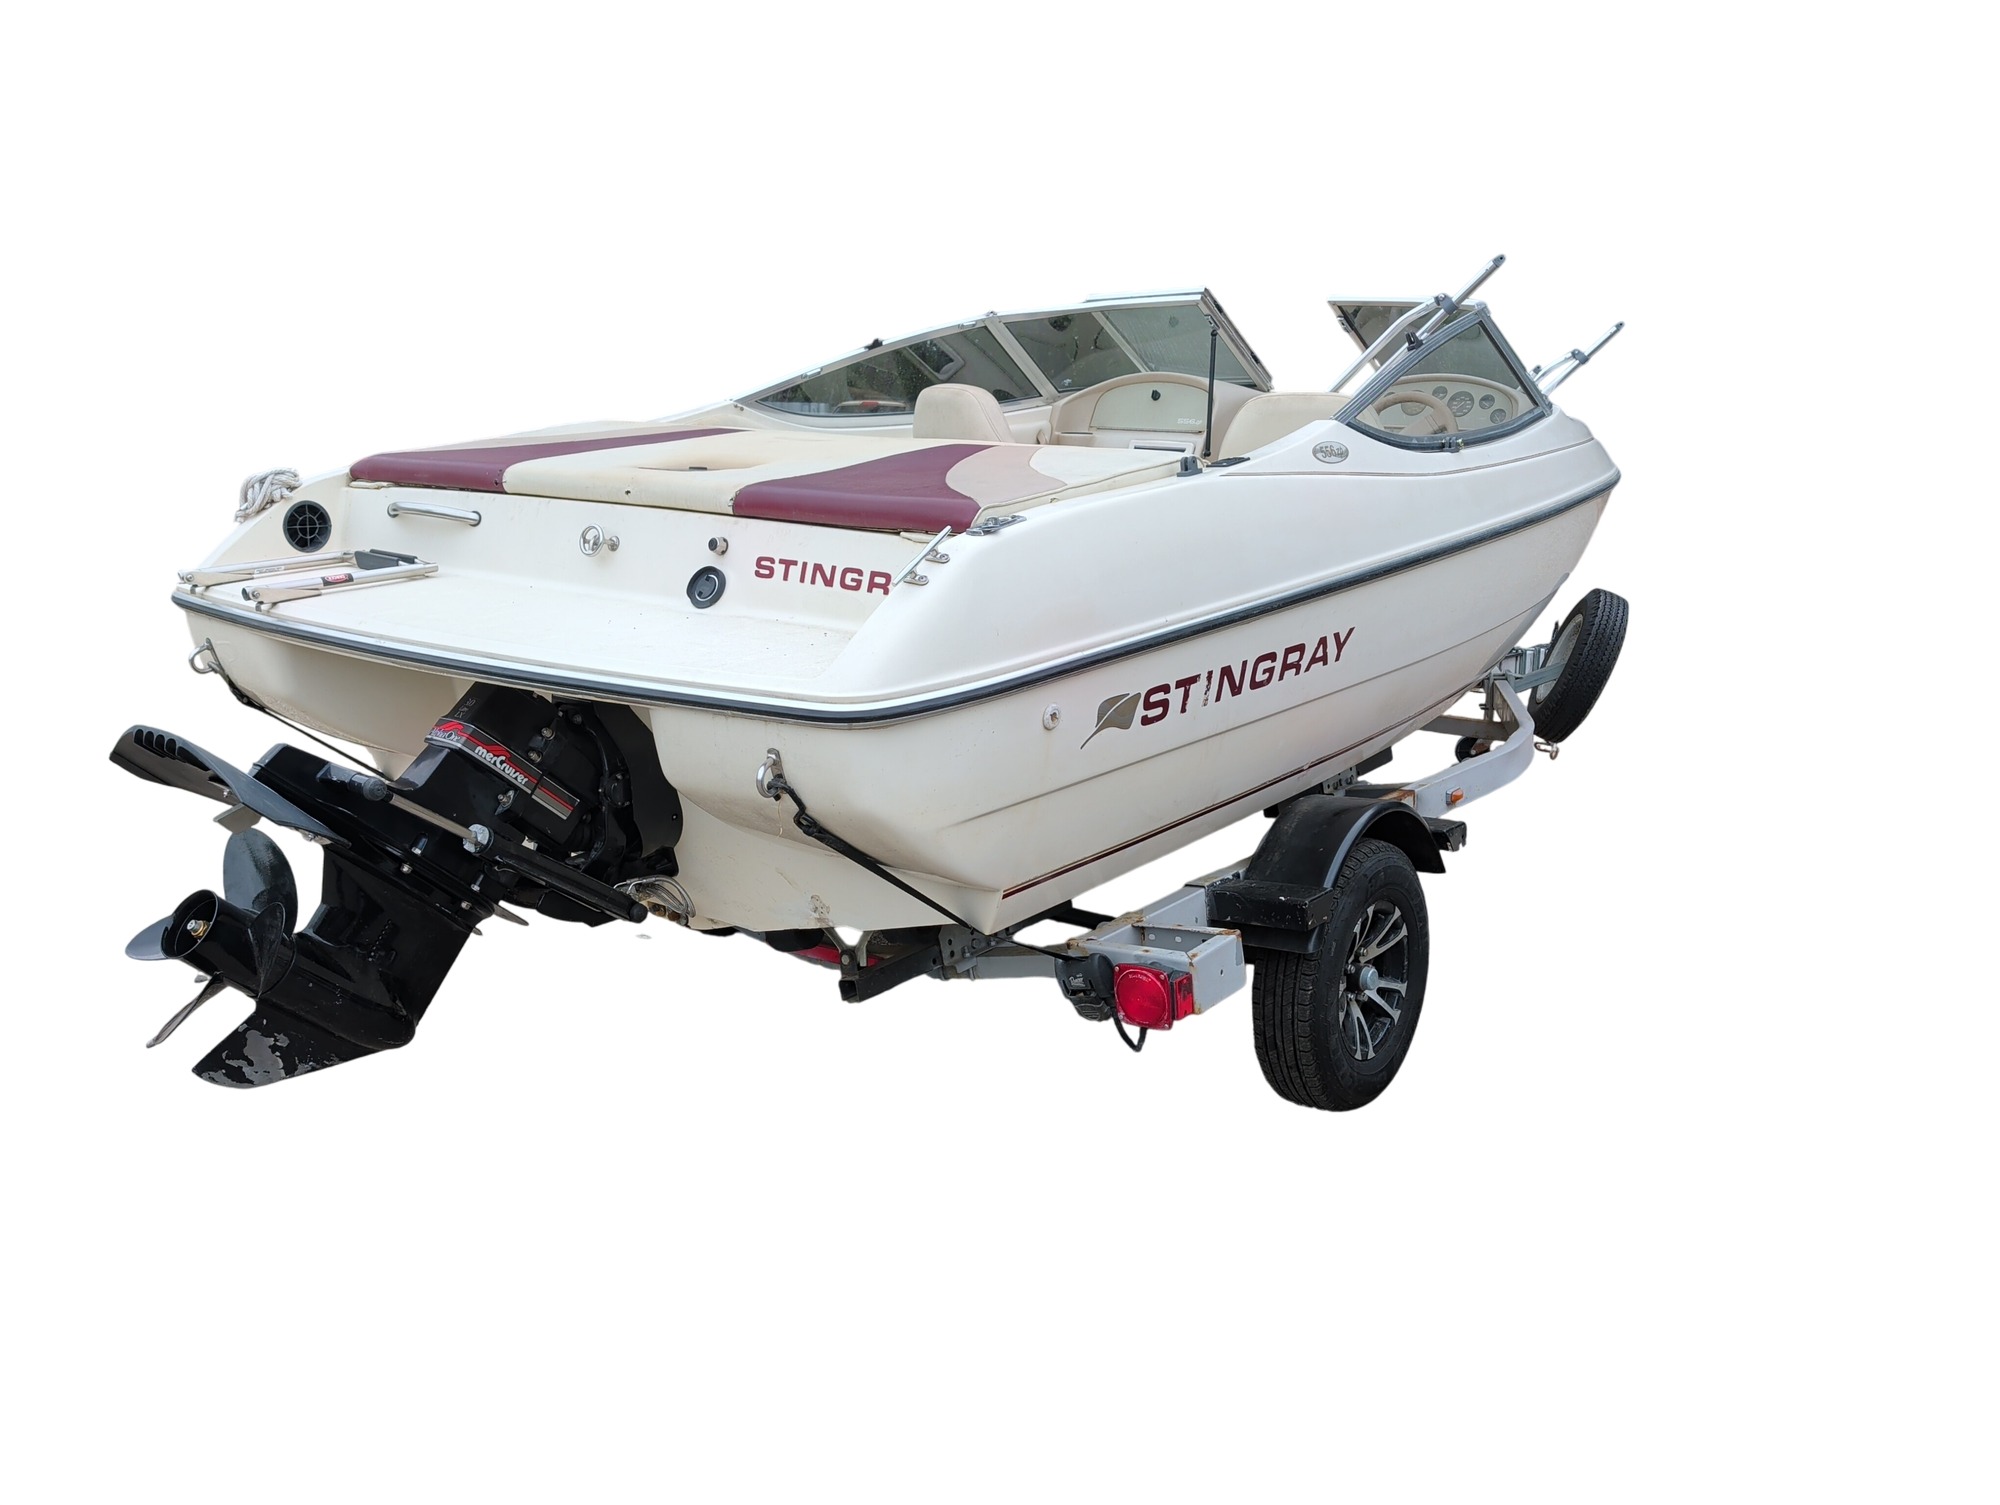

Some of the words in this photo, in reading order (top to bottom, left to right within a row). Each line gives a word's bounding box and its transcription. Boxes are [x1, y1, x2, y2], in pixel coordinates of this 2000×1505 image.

[755, 556, 892, 595] STINGR
[1140, 627, 1355, 727] STINGRAY
[475, 745, 529, 785] merCruiser
